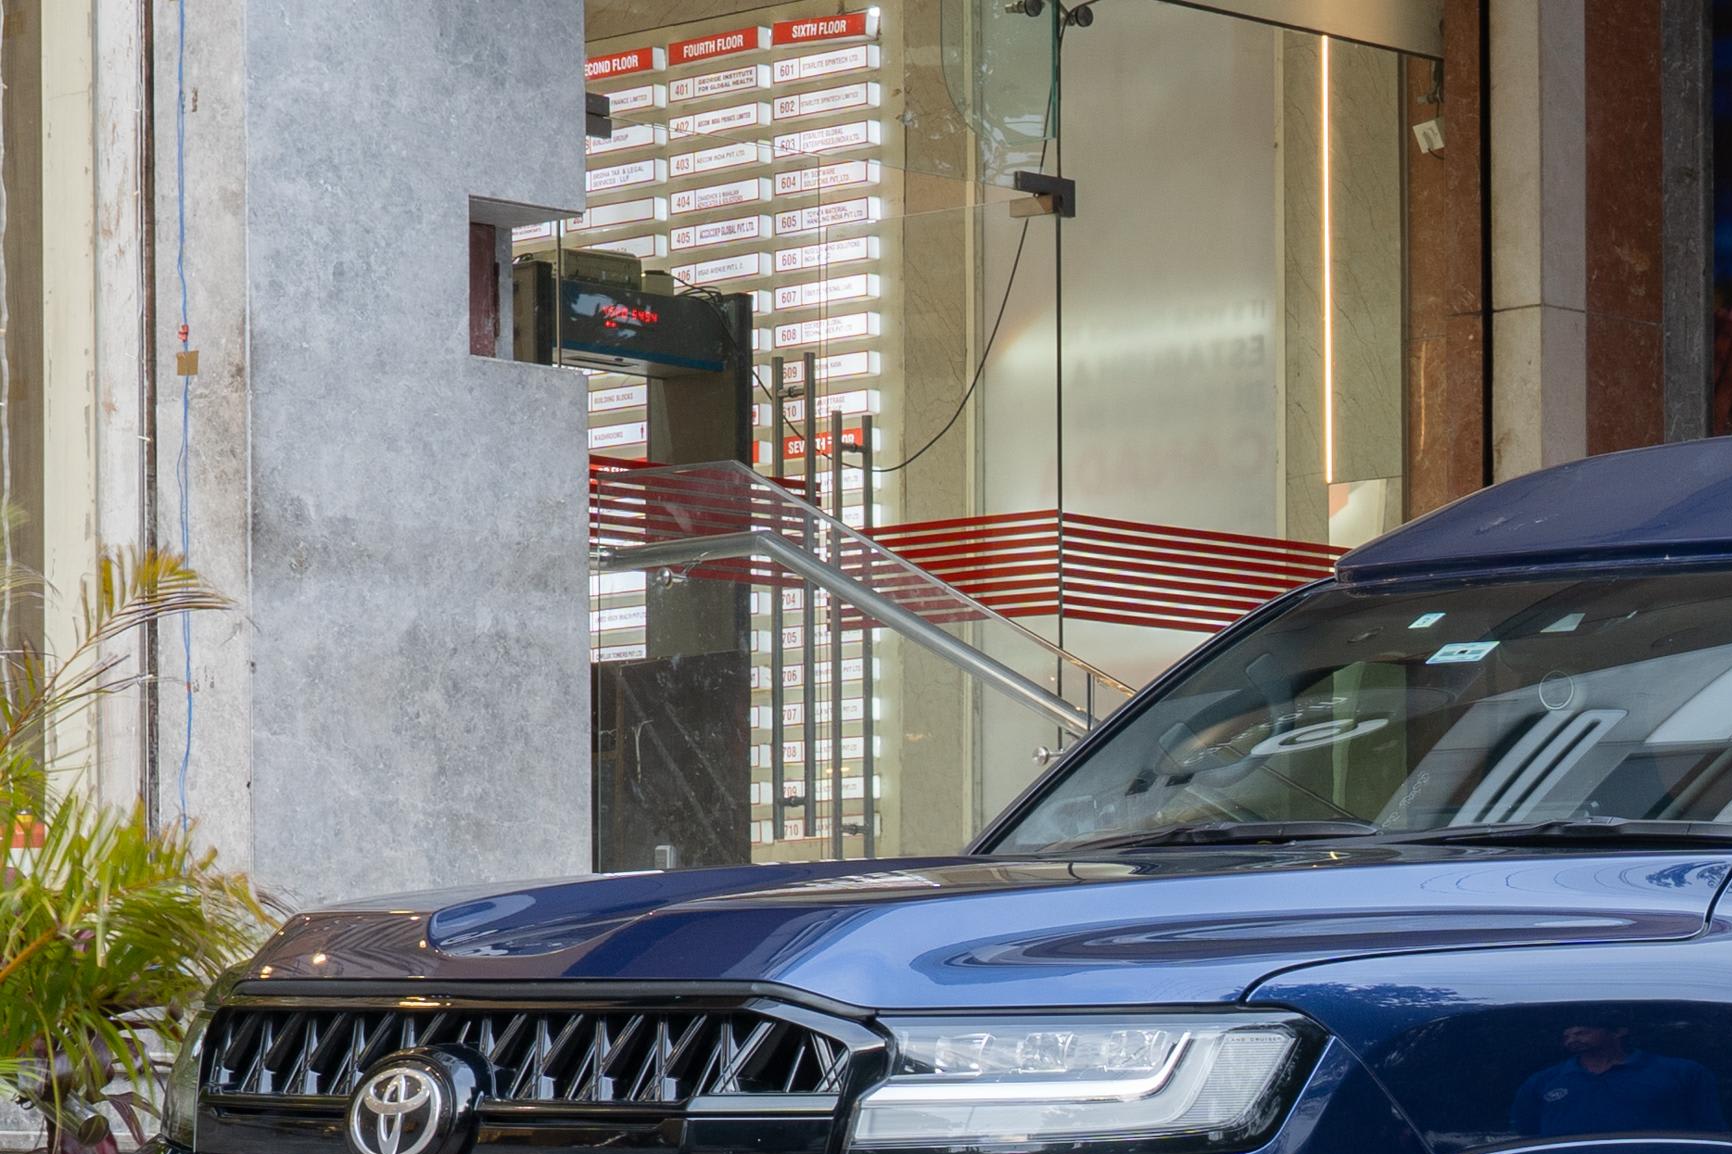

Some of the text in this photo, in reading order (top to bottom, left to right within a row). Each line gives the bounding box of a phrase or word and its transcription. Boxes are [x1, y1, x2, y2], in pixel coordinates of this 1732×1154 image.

[791, 20, 847, 38] SIXTH FLOOR
[683, 34, 744, 58] FOURTH FLOOR
[584, 54, 639, 77] ECOND FLOOR
[780, 65, 794, 77] 601
[674, 84, 689, 96] 401
[698, 76, 754, 92] FOR GLOBAL HEALTH
[780, 101, 795, 113] 602
[675, 158, 690, 170] 403
[781, 176, 796, 189] 604
[676, 195, 691, 207] 404
[781, 215, 797, 229] 605
[676, 232, 691, 244] 405
[781, 253, 797, 266] 606
[781, 290, 797, 304] 607
[781, 328, 796, 341] 608
[788, 436, 826, 454] SEVTH
